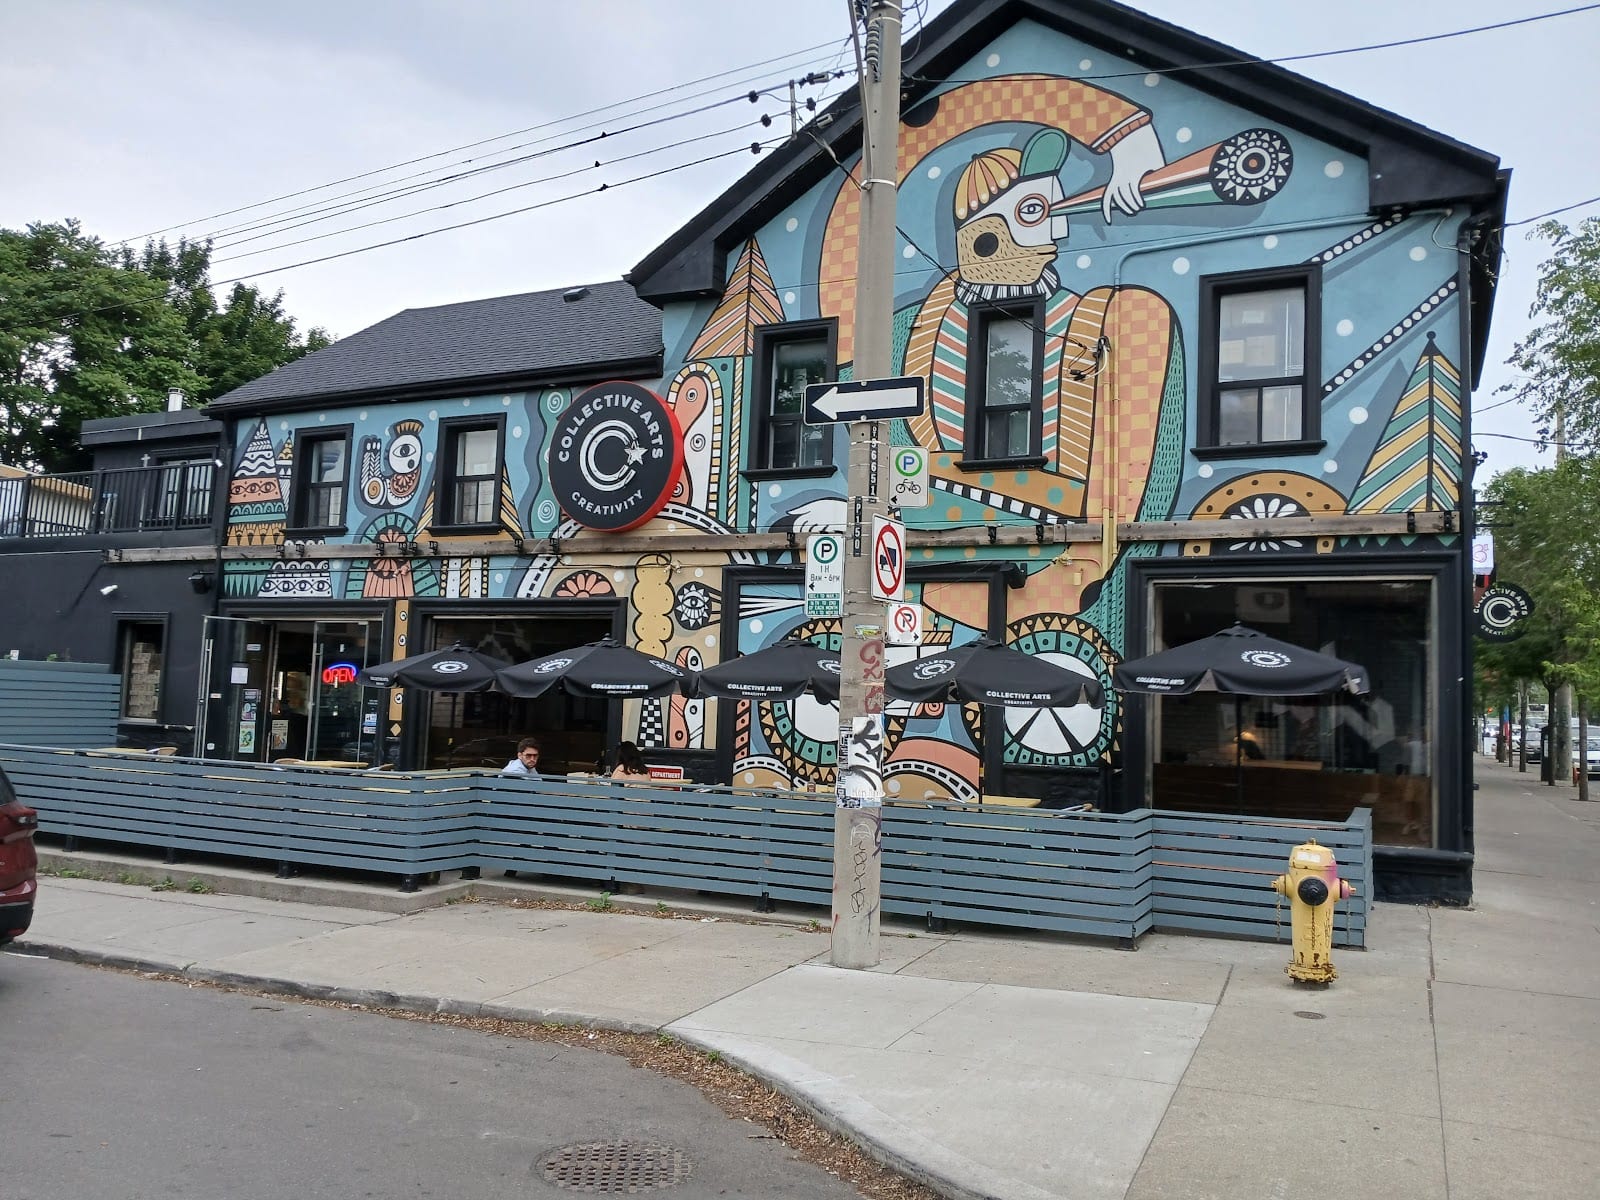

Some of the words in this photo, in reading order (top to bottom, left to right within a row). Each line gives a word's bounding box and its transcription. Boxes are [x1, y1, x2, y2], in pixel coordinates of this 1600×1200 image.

[558, 394, 643, 462] COLLECTIVE
[640, 411, 664, 459] ARTS
[903, 455, 915, 470] P
[571, 489, 643, 515] CREATIVITY
[821, 543, 833, 558] P
[322, 667, 354, 683] OPEN
[727, 683, 765, 692] COLLECTIVE
[986, 690, 1031, 700] COLLECTIVE
[651, 771, 681, 779] DEPARTMENT
